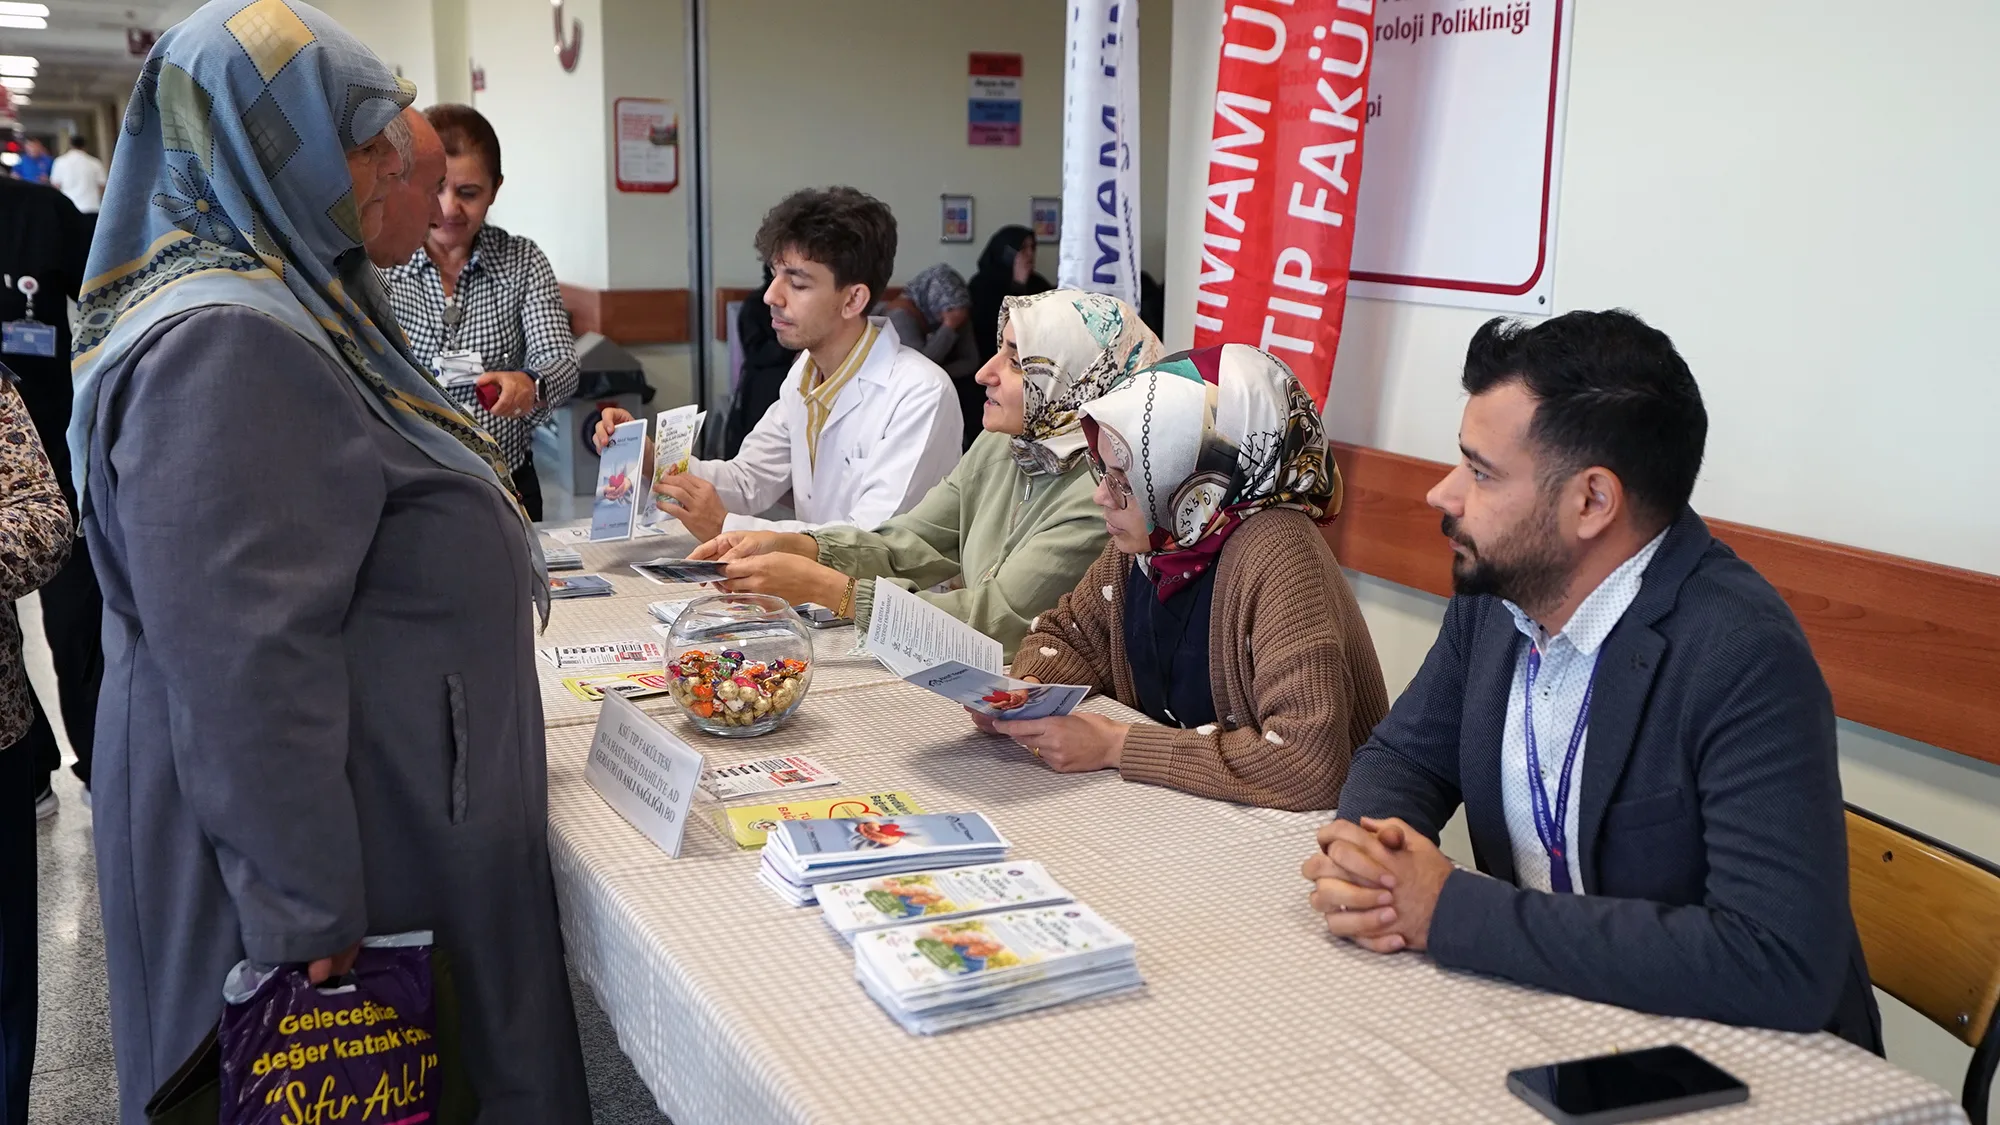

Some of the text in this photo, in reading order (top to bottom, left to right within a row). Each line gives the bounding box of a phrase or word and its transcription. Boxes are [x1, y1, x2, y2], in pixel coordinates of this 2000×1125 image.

[1431, 2, 1531, 36] Polikliniği
[1259, 246, 1328, 354] TIP
[595, 749, 619, 775] GERİATRİ
[618, 722, 672, 773] KSÜ TIP FAKÜLTESİ
[609, 738, 640, 771] HASTANESİ
[638, 762, 669, 796] DAHİLİYE
[666, 785, 680, 803] AD
[251, 1043, 329, 1076] değer
